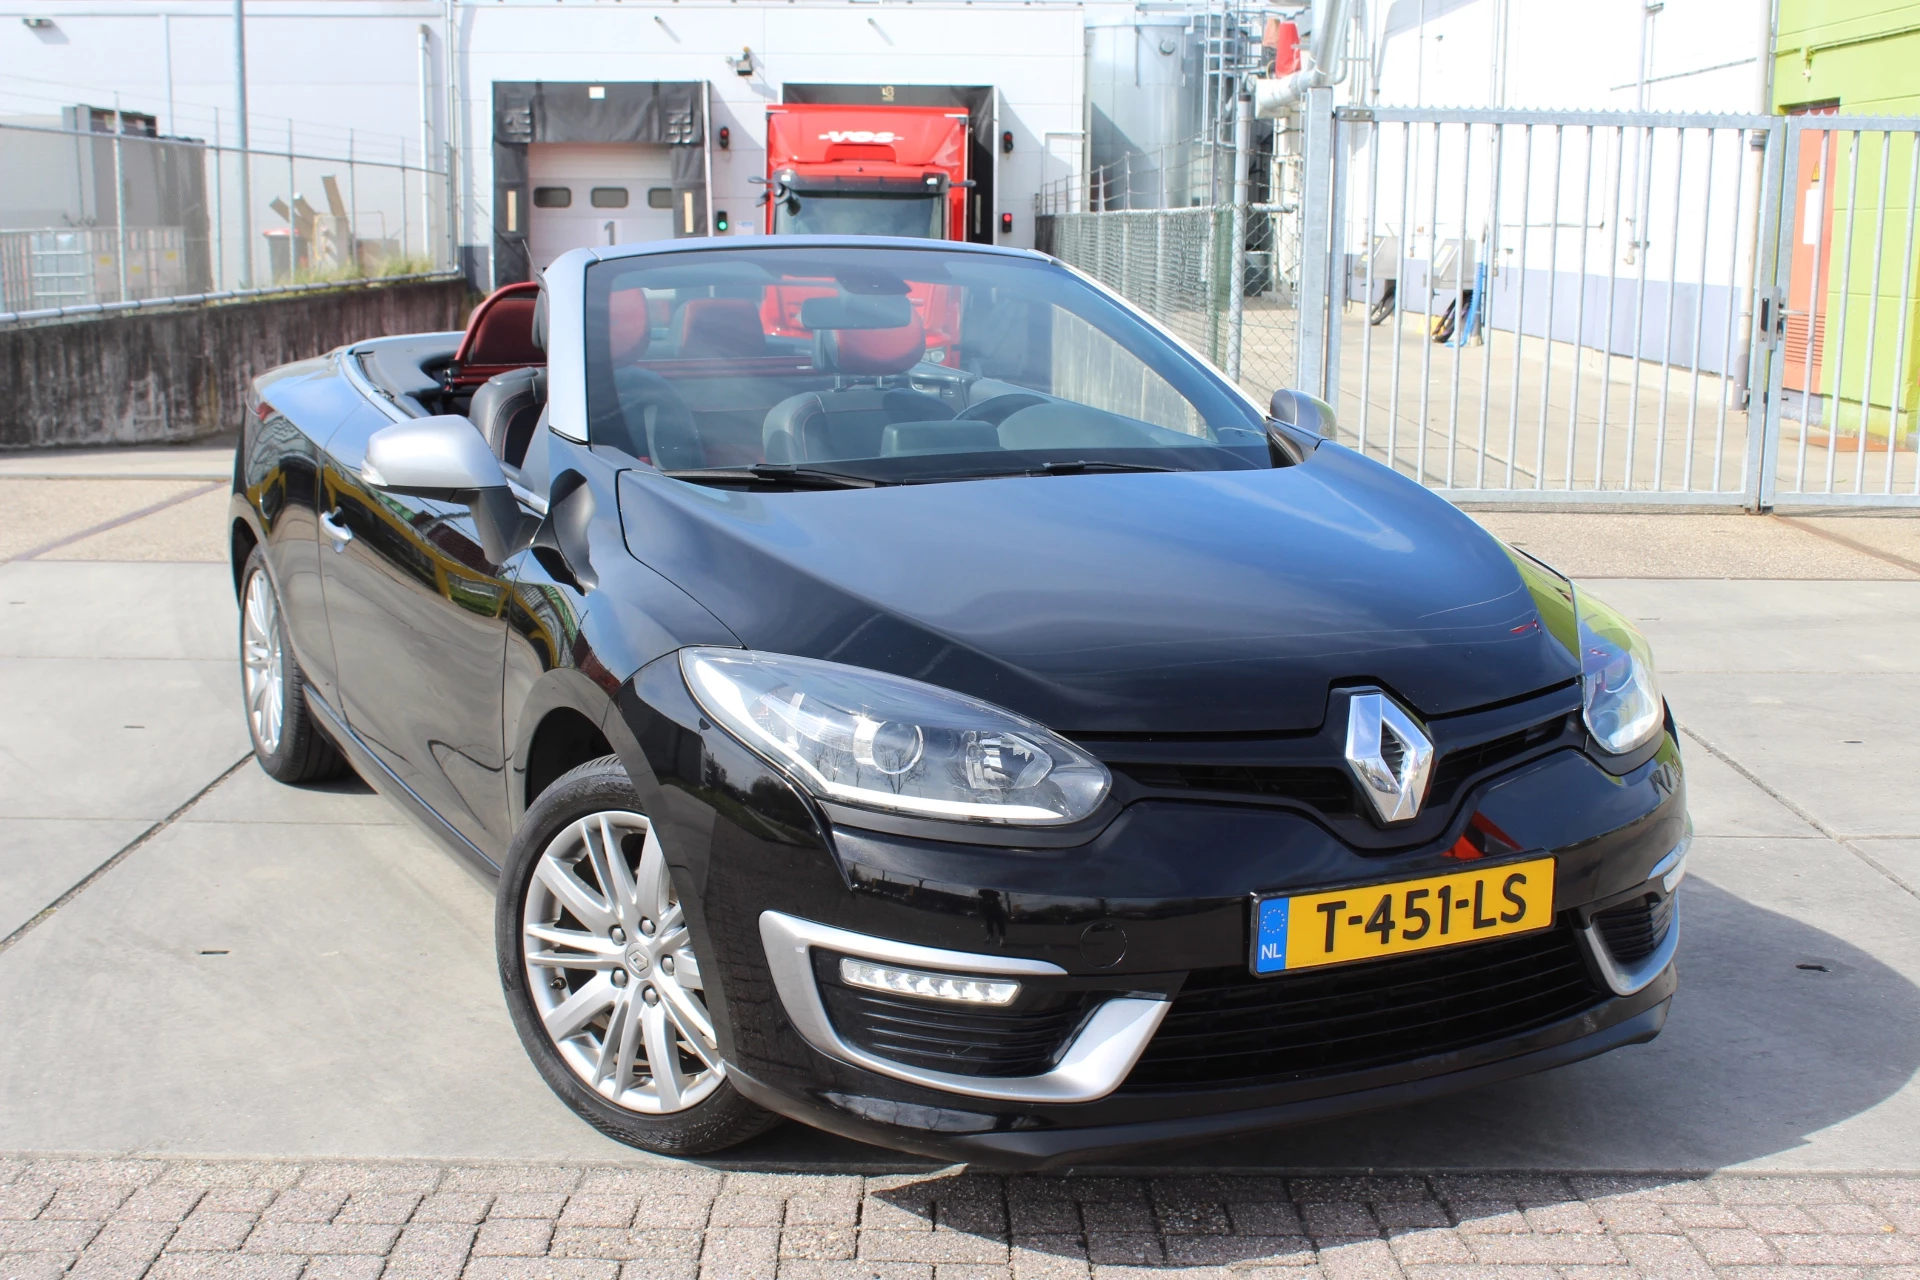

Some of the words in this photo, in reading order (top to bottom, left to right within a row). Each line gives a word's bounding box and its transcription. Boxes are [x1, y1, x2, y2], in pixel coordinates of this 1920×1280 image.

[604, 221, 615, 246] 1
[1316, 873, 1527, 953] T-451-LS
[1261, 943, 1282, 960] NL
